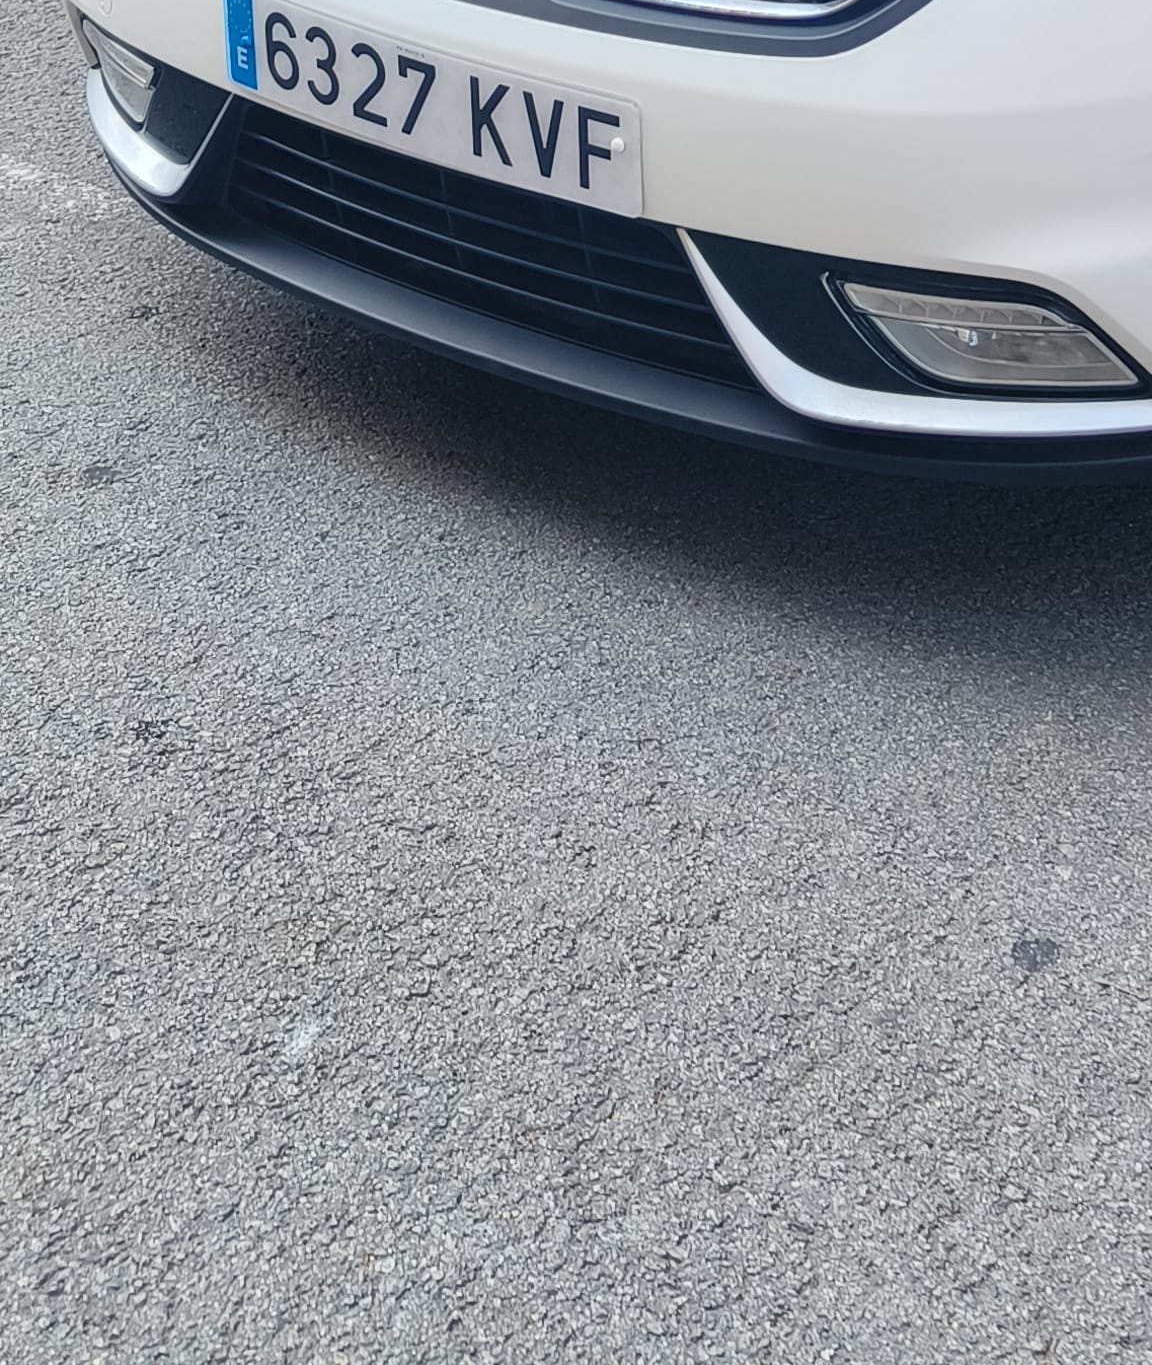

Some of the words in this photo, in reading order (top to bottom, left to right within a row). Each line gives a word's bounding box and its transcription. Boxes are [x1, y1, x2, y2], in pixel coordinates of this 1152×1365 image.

[235, 44, 250, 71] E
[264, 11, 437, 136] 6327
[468, 74, 621, 190] KVF
